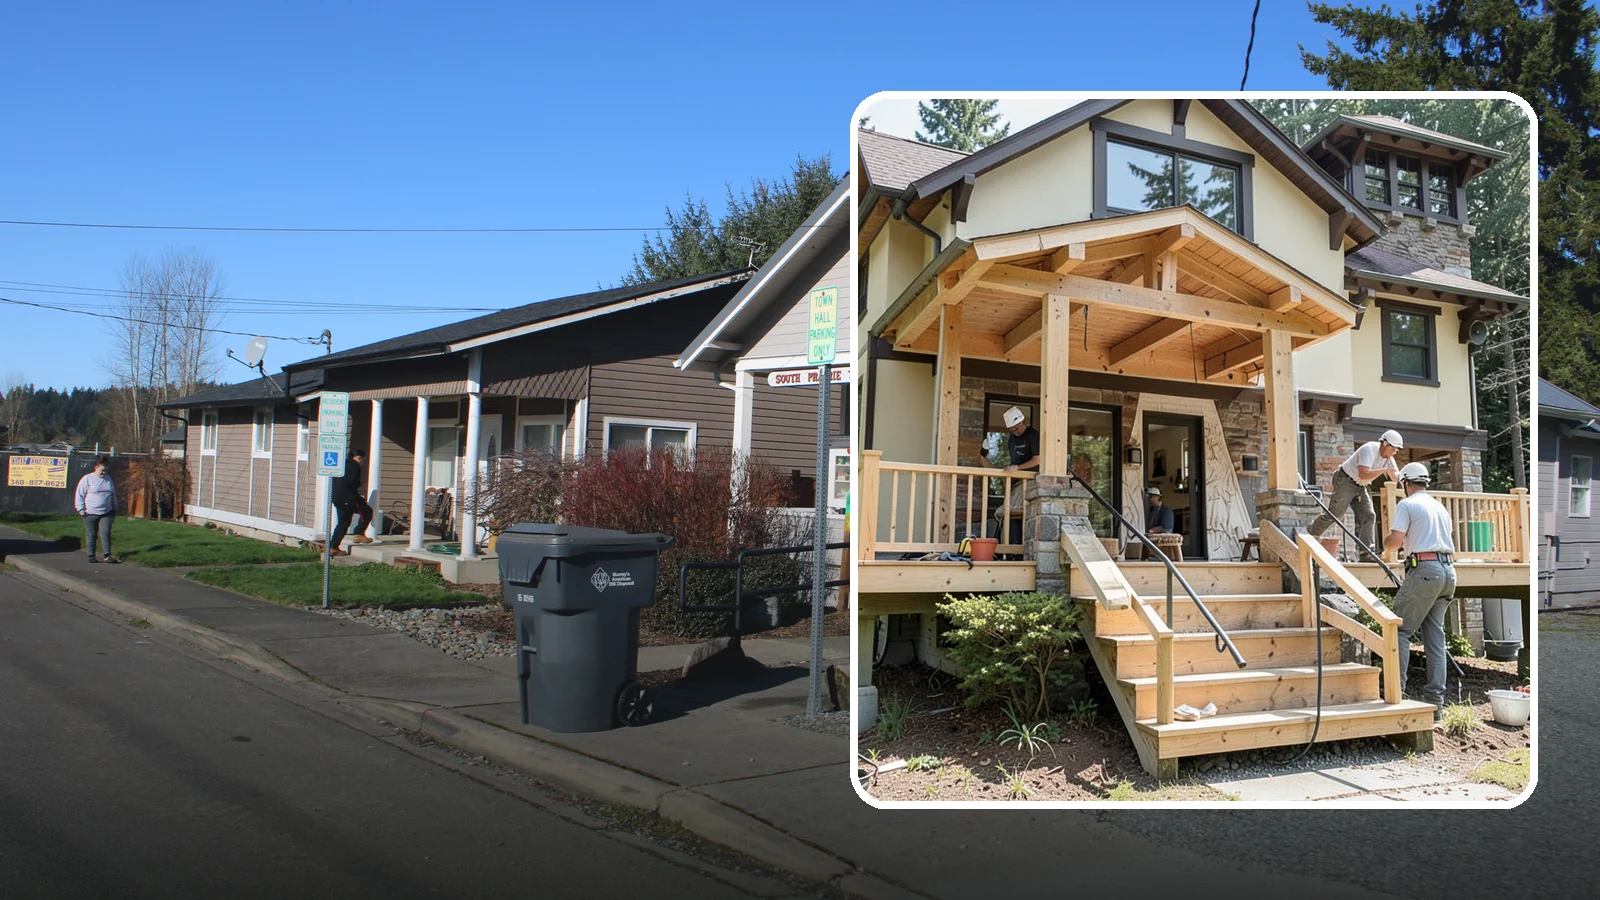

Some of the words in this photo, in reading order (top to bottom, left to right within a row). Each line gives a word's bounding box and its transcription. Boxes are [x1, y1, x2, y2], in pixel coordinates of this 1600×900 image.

[815, 295, 833, 307] TOWN
[814, 312, 831, 324] HALL
[810, 327, 836, 340] PARKING
[813, 344, 831, 357] ONLY
[775, 374, 801, 384] SOUTH
[807, 370, 842, 382] PRIE
